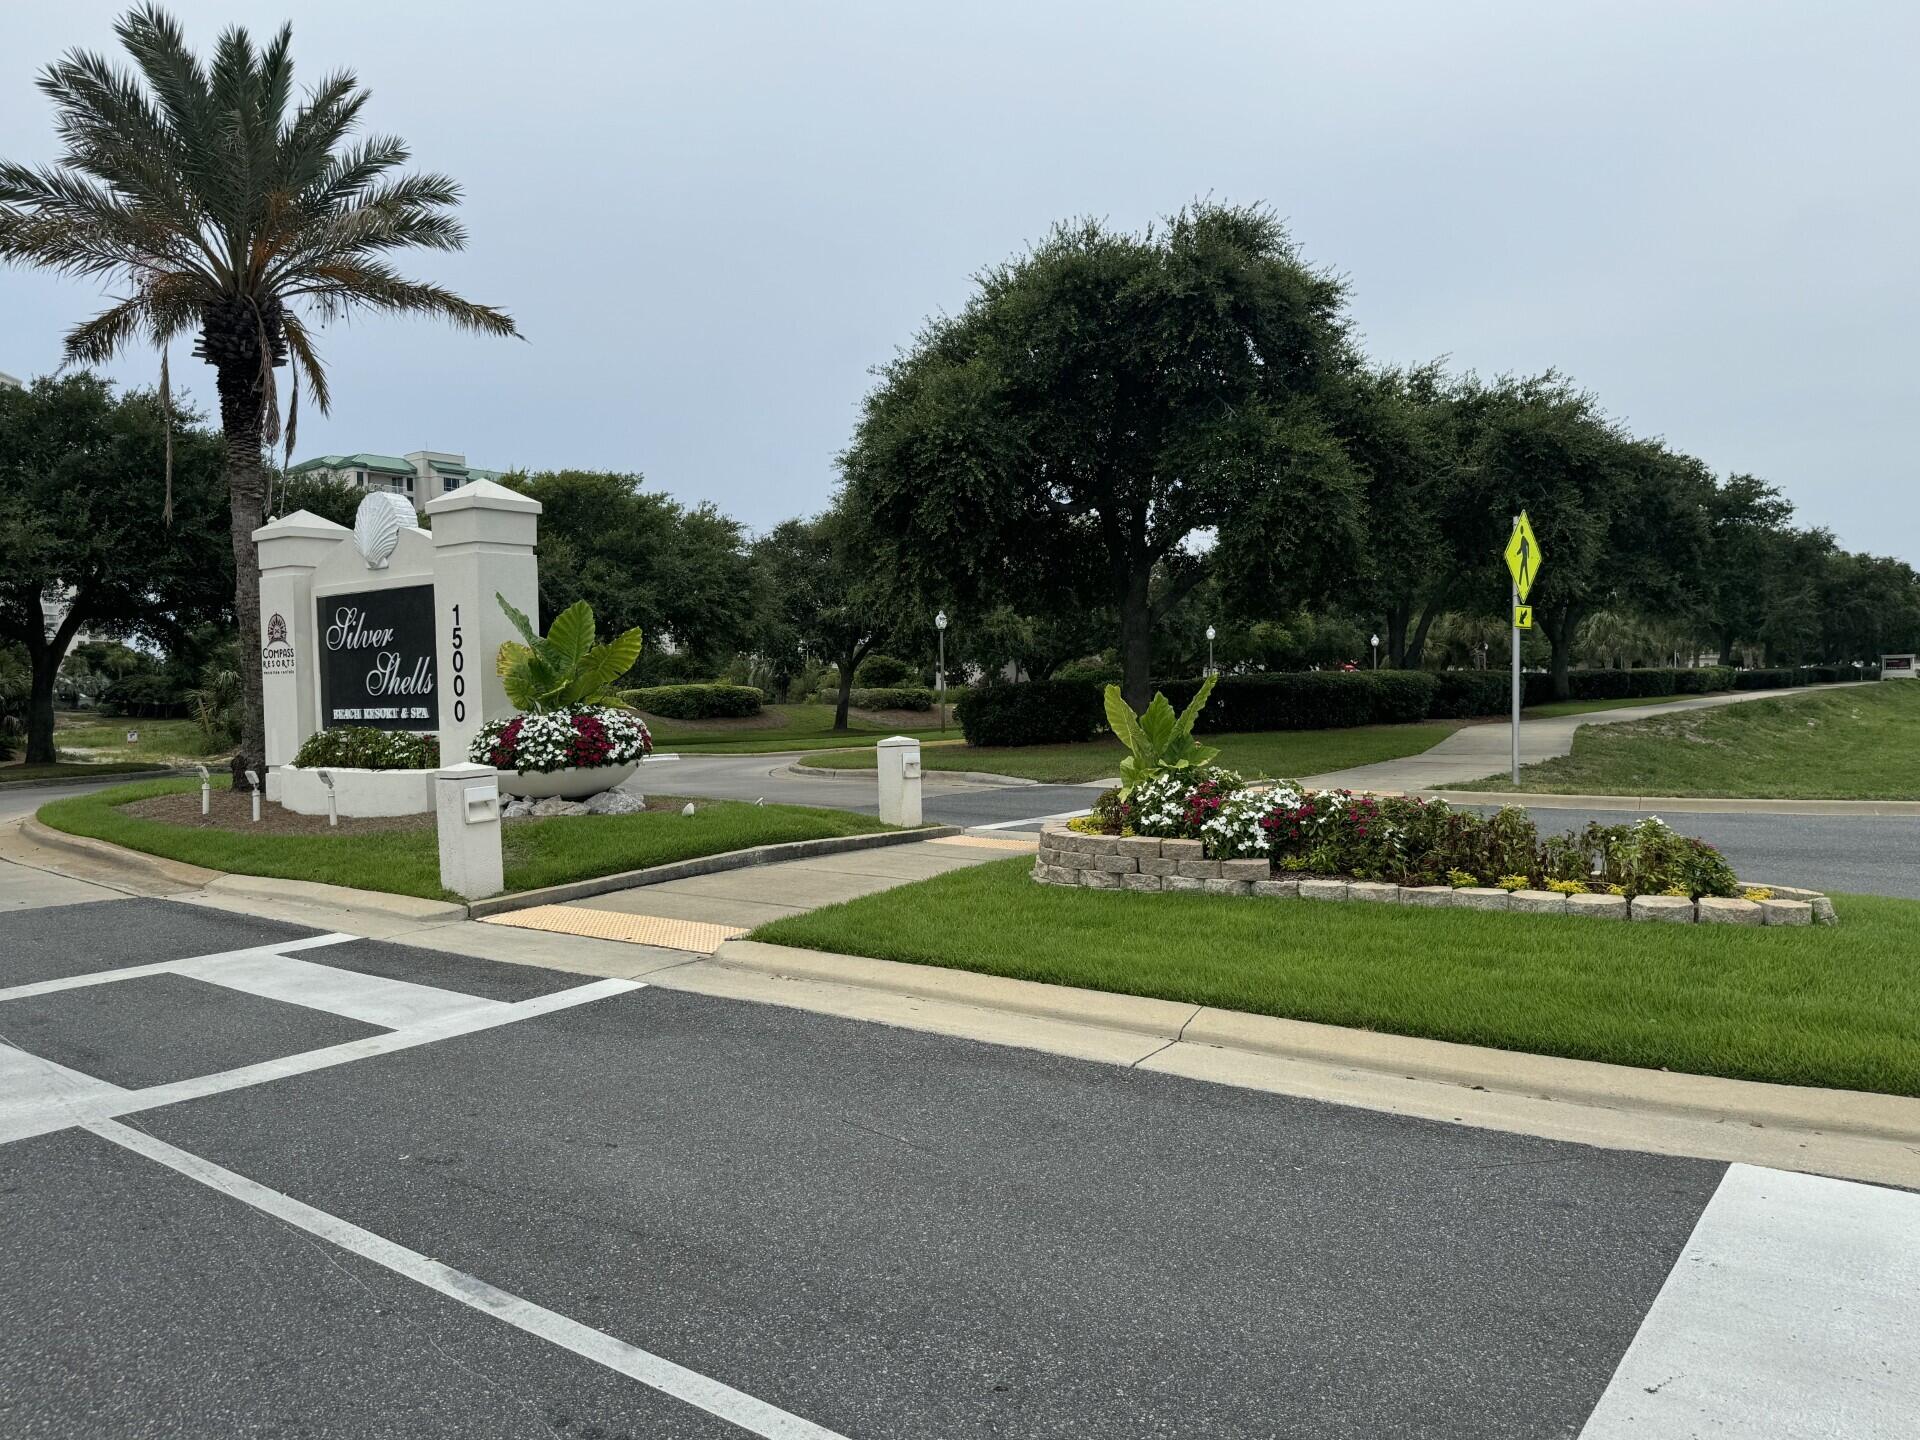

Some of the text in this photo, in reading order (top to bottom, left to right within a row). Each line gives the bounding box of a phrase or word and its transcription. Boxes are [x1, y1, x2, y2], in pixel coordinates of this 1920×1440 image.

[326, 607, 394, 650] Silver
[263, 648, 294, 659] COMPASS
[263, 660, 295, 669] RESORTS
[452, 604, 465, 722] 15000
[366, 651, 433, 696] Shells
[333, 707, 430, 719] BEACH RESORT & SPA
